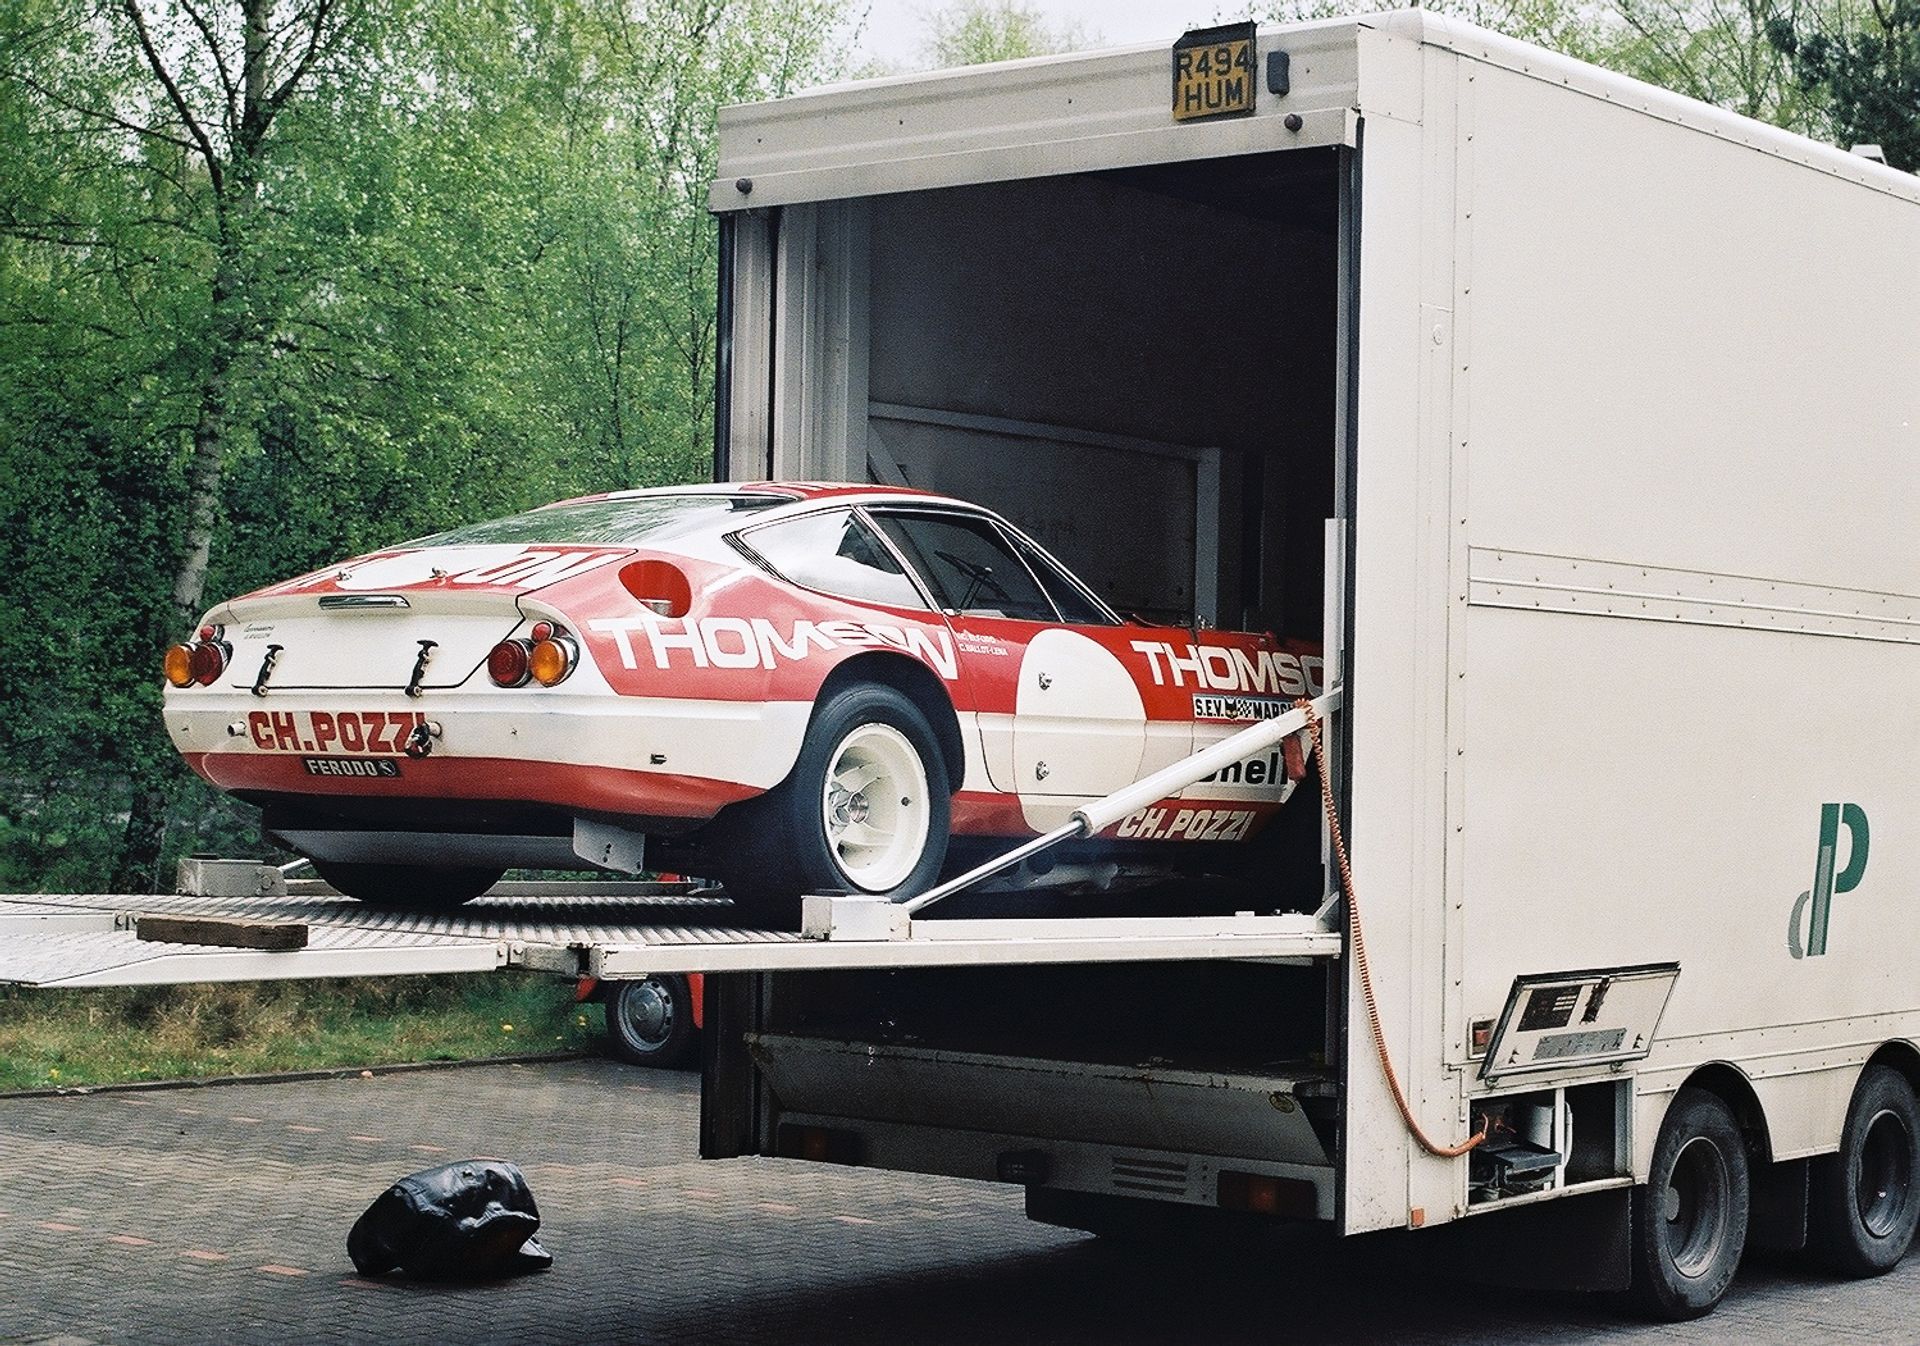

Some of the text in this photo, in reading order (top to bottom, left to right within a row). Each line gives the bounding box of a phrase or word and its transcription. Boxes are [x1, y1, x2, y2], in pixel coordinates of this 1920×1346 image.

[1177, 46, 1249, 82] R494
[1184, 77, 1243, 111] HUM
[588, 616, 959, 681] THOMSON
[1194, 697, 1225, 717] S.E.V.
[306, 759, 378, 776] FERODO
[1116, 807, 1257, 840] CH.POZZI
